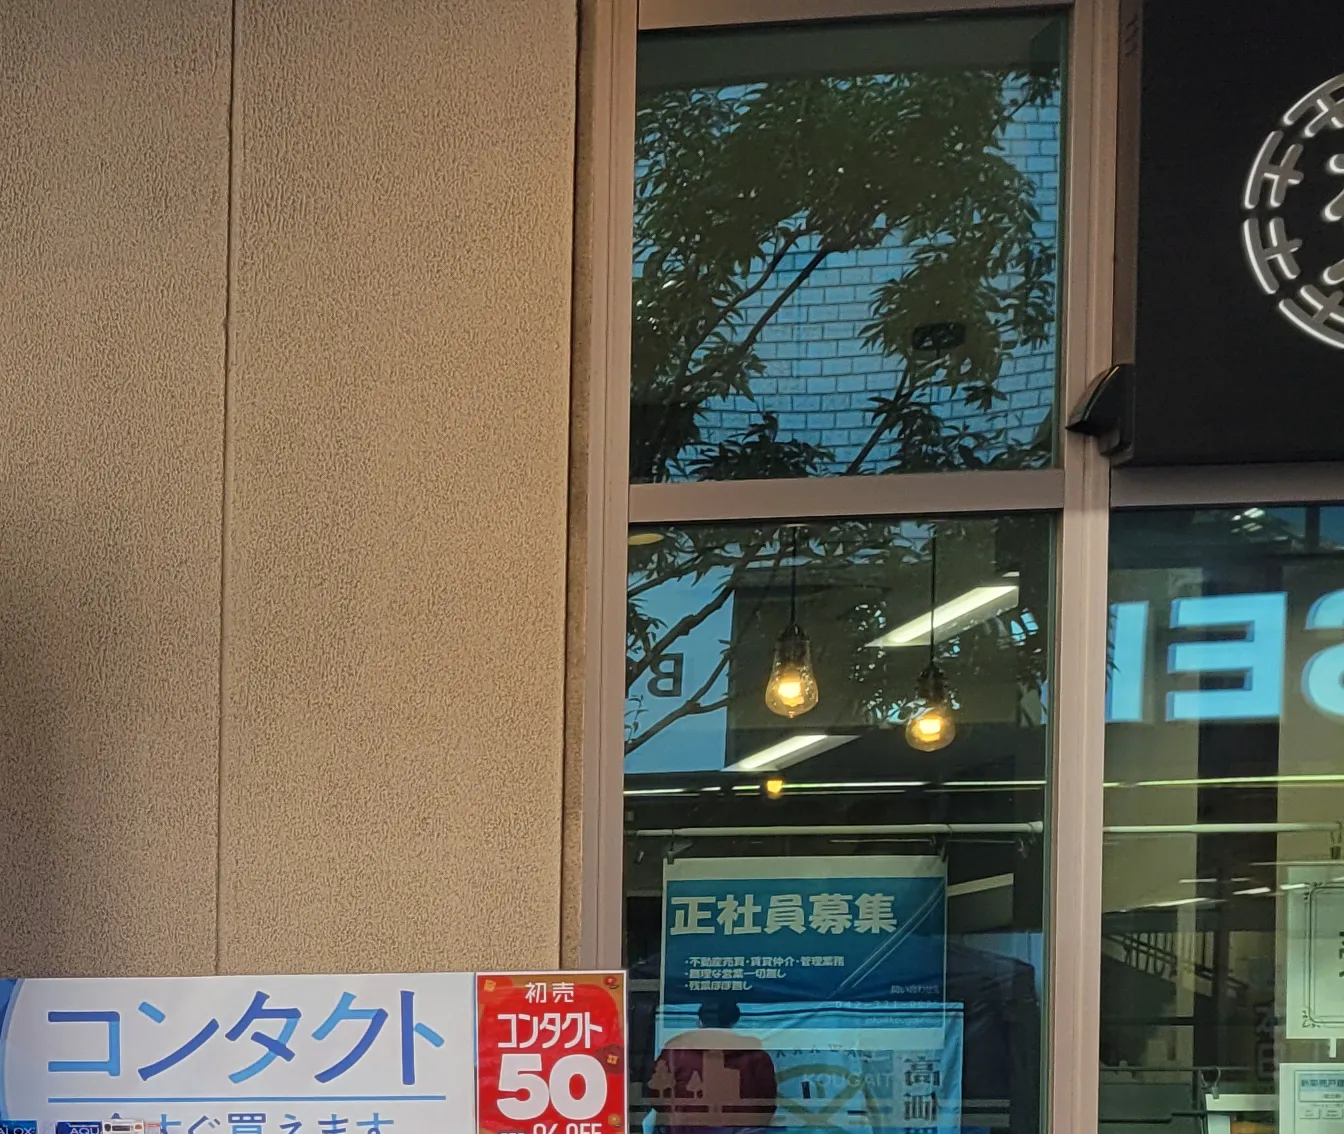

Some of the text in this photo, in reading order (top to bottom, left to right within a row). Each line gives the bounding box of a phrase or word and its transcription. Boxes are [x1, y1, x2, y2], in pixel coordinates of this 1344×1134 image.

[669, 892, 897, 936] 正社員募集
[525, 982, 575, 1004] 初売
[47, 990, 445, 1087] コンタクト
[497, 1011, 603, 1050] コンタクト
[496, 1053, 608, 1121] 50
